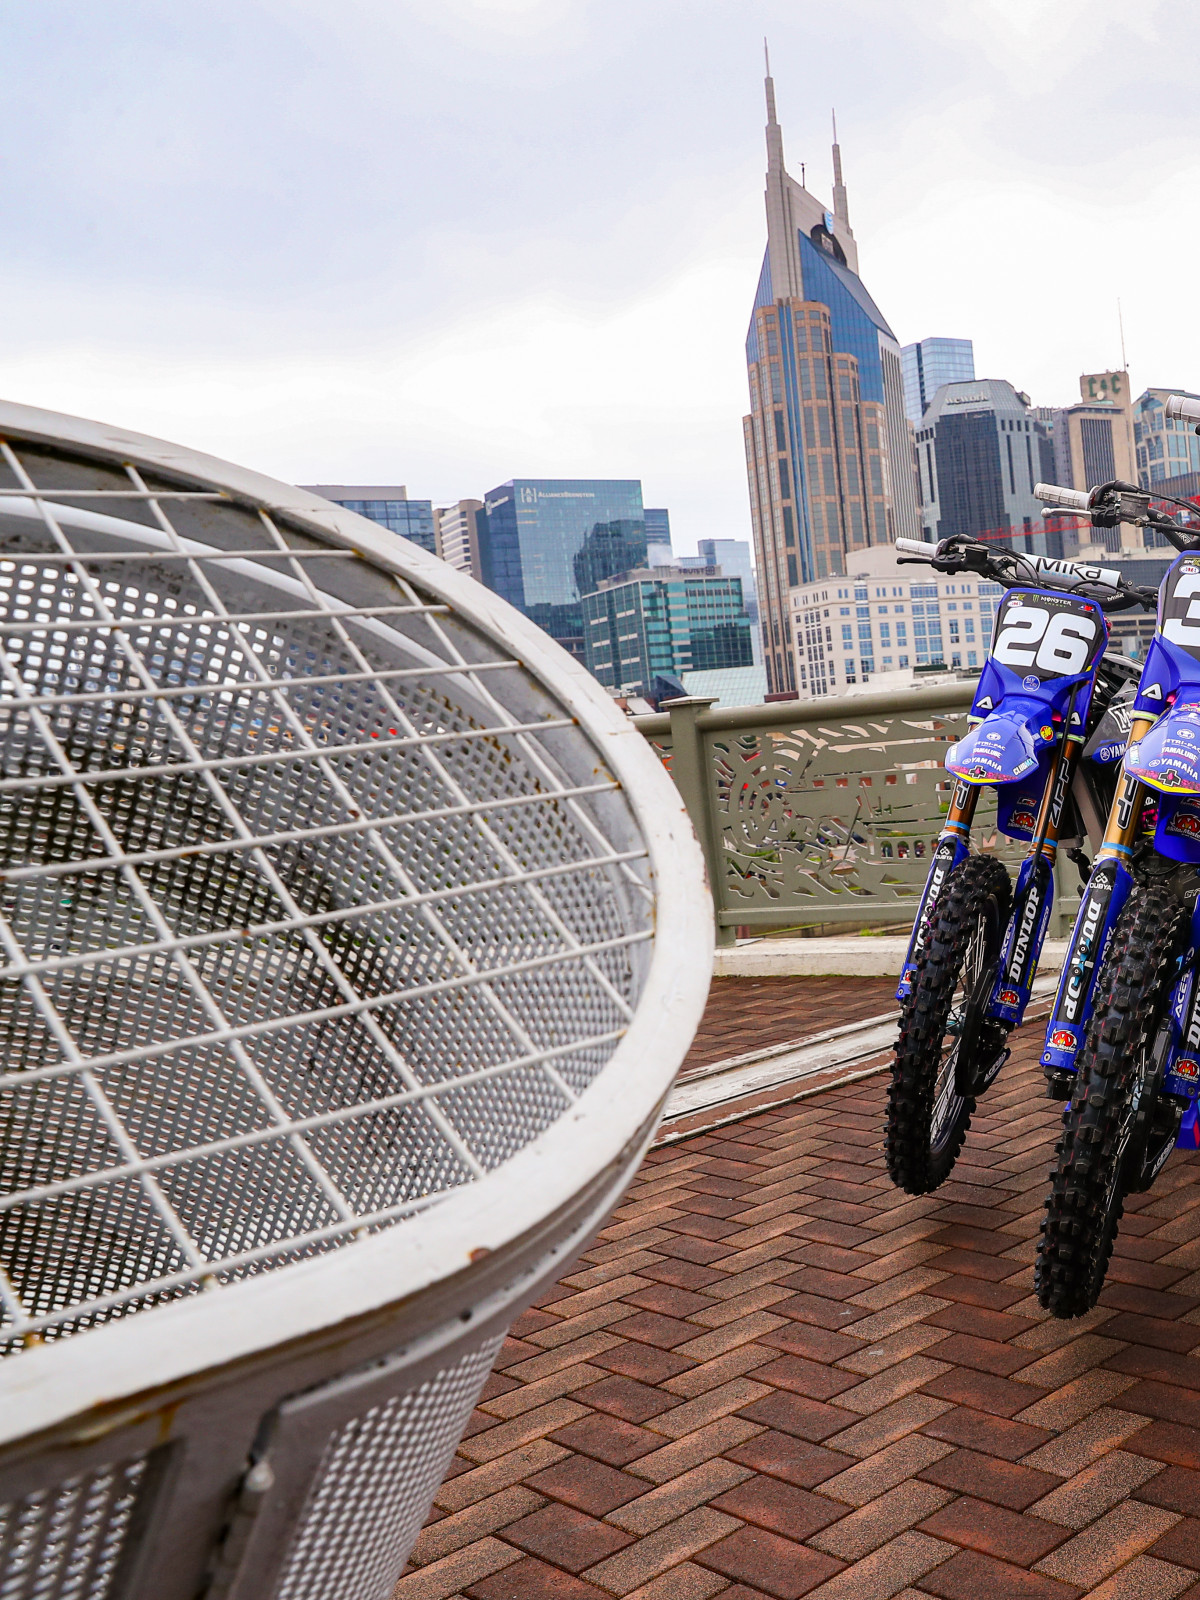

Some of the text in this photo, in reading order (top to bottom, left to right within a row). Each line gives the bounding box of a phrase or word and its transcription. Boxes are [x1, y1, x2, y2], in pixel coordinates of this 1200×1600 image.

[945, 391, 988, 405] wework
[1035, 557, 1102, 580] Mika
[1041, 596, 1072, 606] MONSTER
[992, 606, 1097, 676] 26
[1108, 743, 1126, 758] YAM
[1161, 746, 1199, 763] YAMALUBE
[970, 756, 1002, 772] YAMAHA
[1160, 758, 1199, 780] YAMAHA
[1089, 882, 1112, 891] DUBYA
[1008, 886, 1040, 983] DUNLOP
